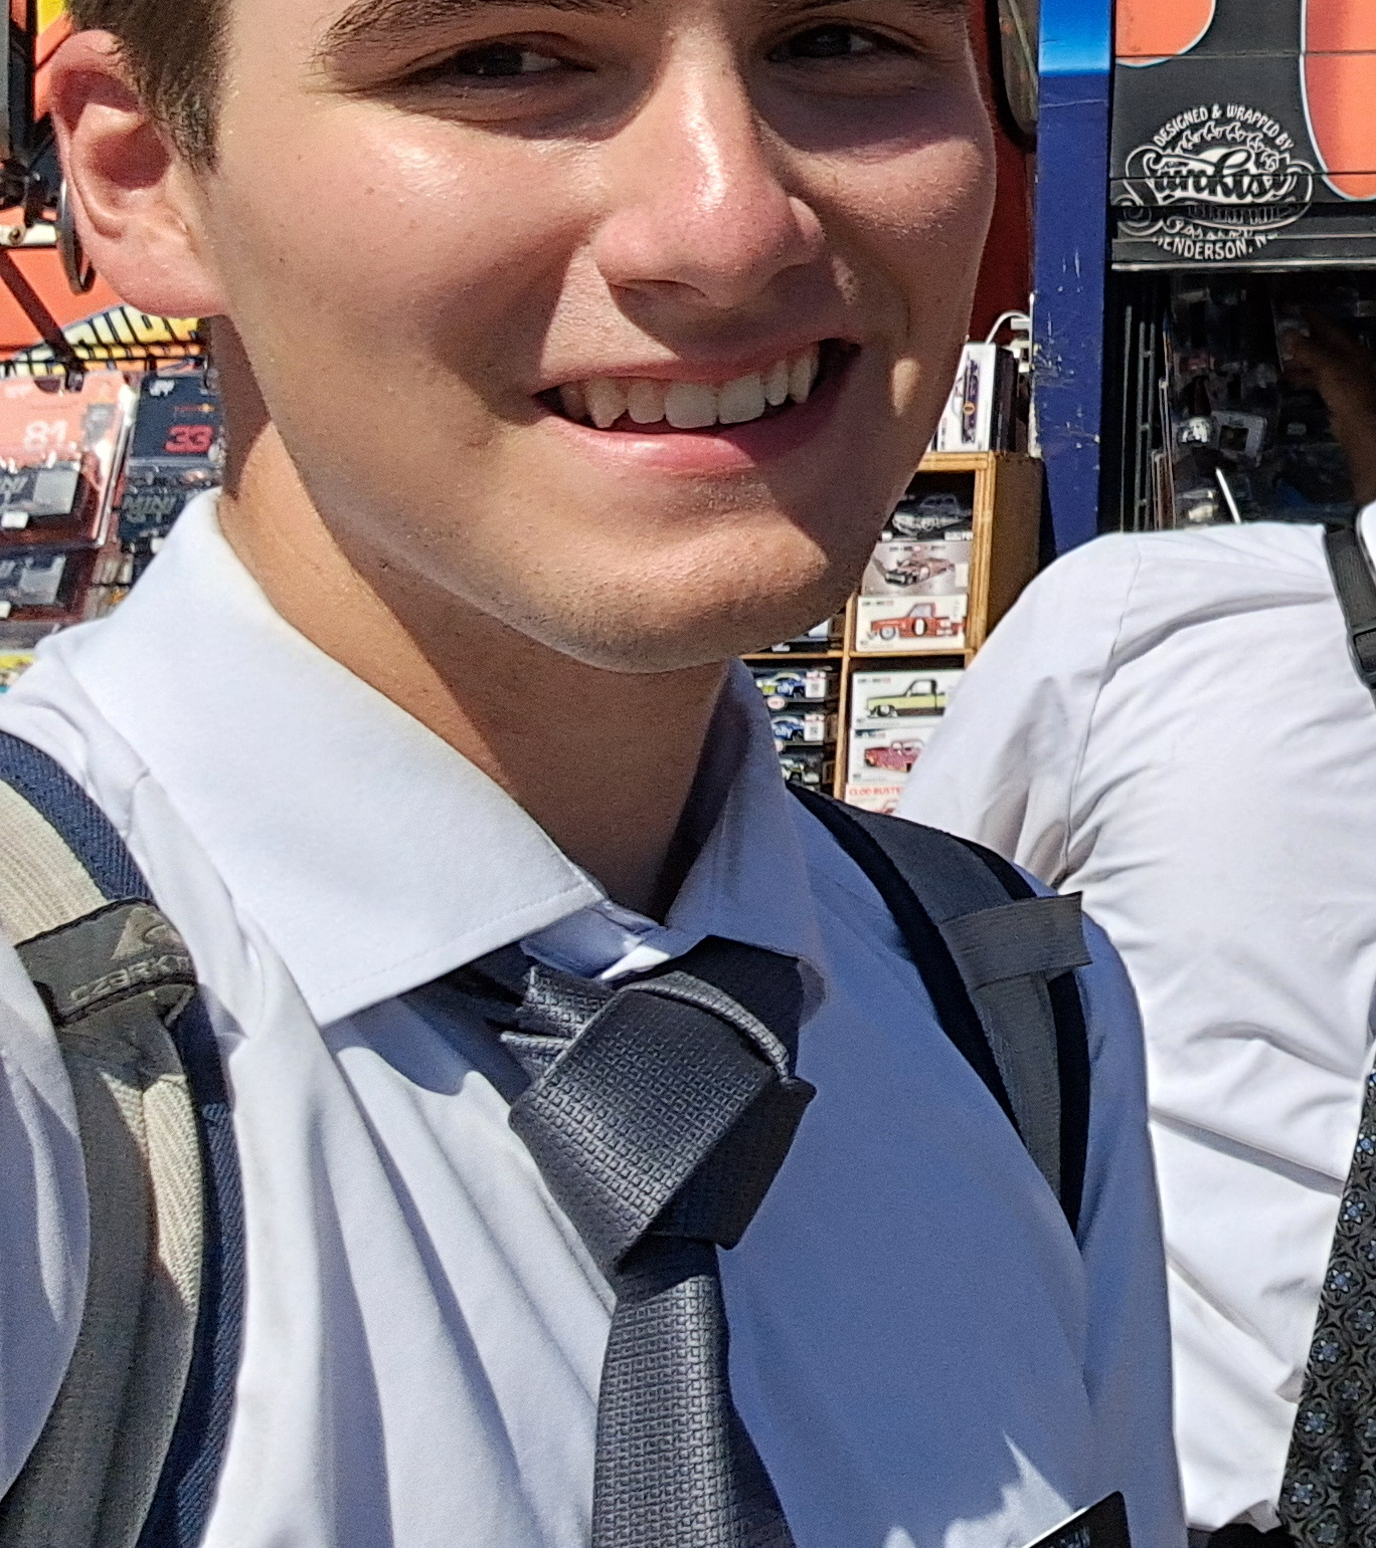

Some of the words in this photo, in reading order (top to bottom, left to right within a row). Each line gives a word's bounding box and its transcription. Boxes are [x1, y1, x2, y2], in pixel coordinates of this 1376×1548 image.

[1153, 106, 1208, 147] DESIGNED
[1211, 103, 1222, 119] &
[1226, 104, 1280, 138] WRAPPED
[1274, 132, 1295, 150] BY
[164, 424, 214, 453] 33
